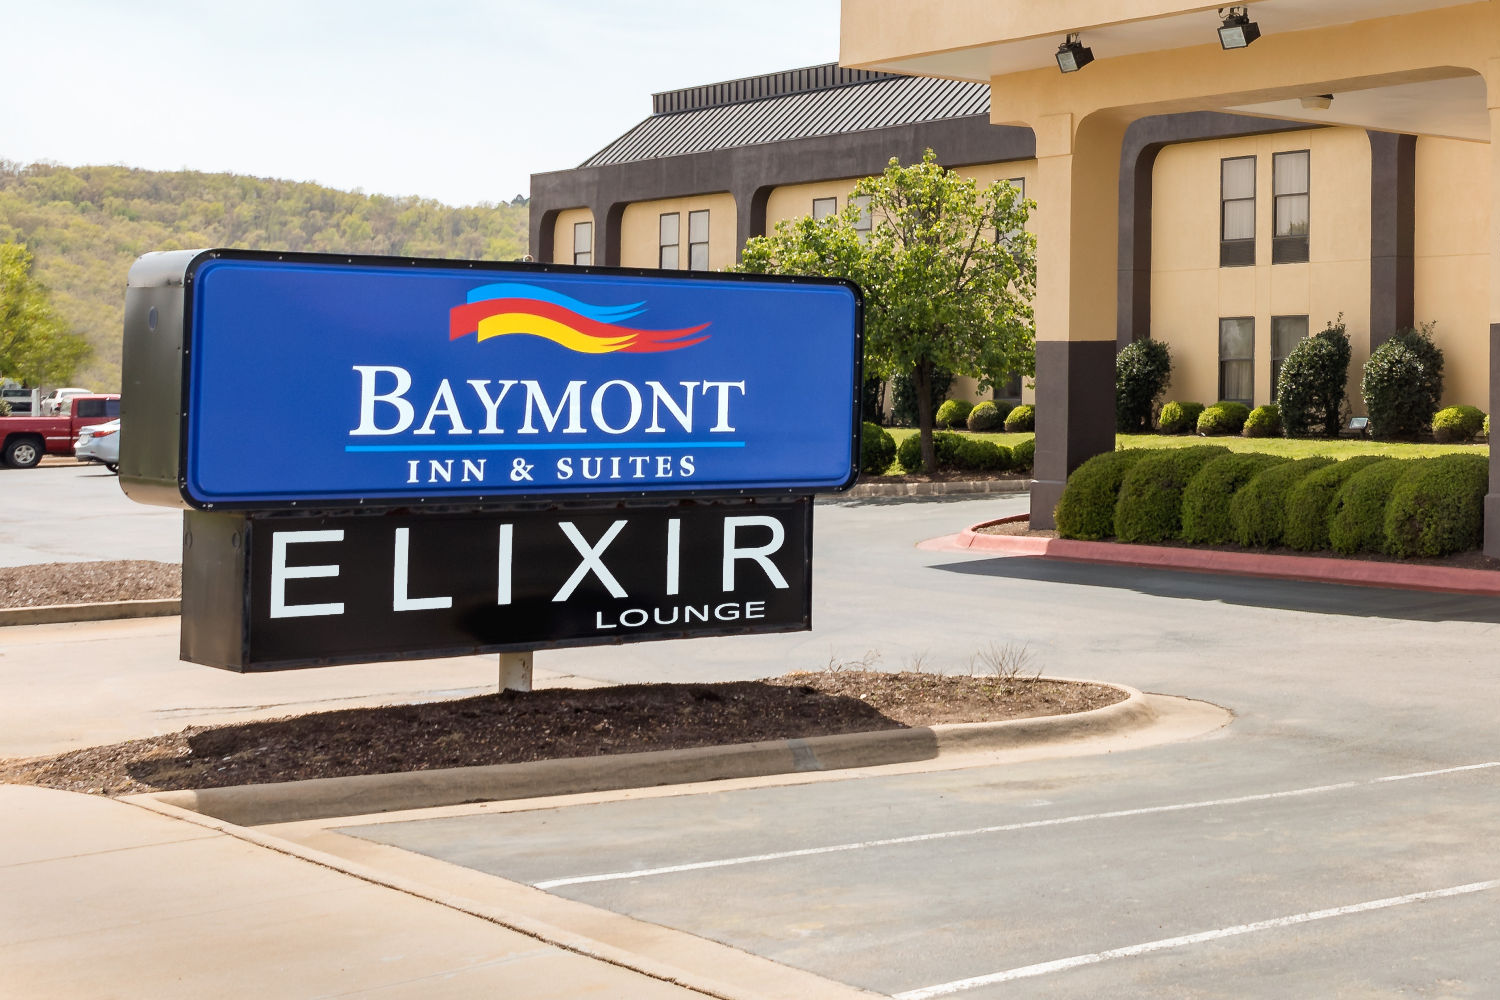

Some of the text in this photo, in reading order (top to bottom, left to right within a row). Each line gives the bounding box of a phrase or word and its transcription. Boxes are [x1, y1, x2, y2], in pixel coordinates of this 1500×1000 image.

[348, 364, 746, 437] BAYMONT
[407, 454, 697, 484] INN & SUITES
[270, 515, 790, 619] ELIXIR
[596, 600, 766, 629] LOUNGE
